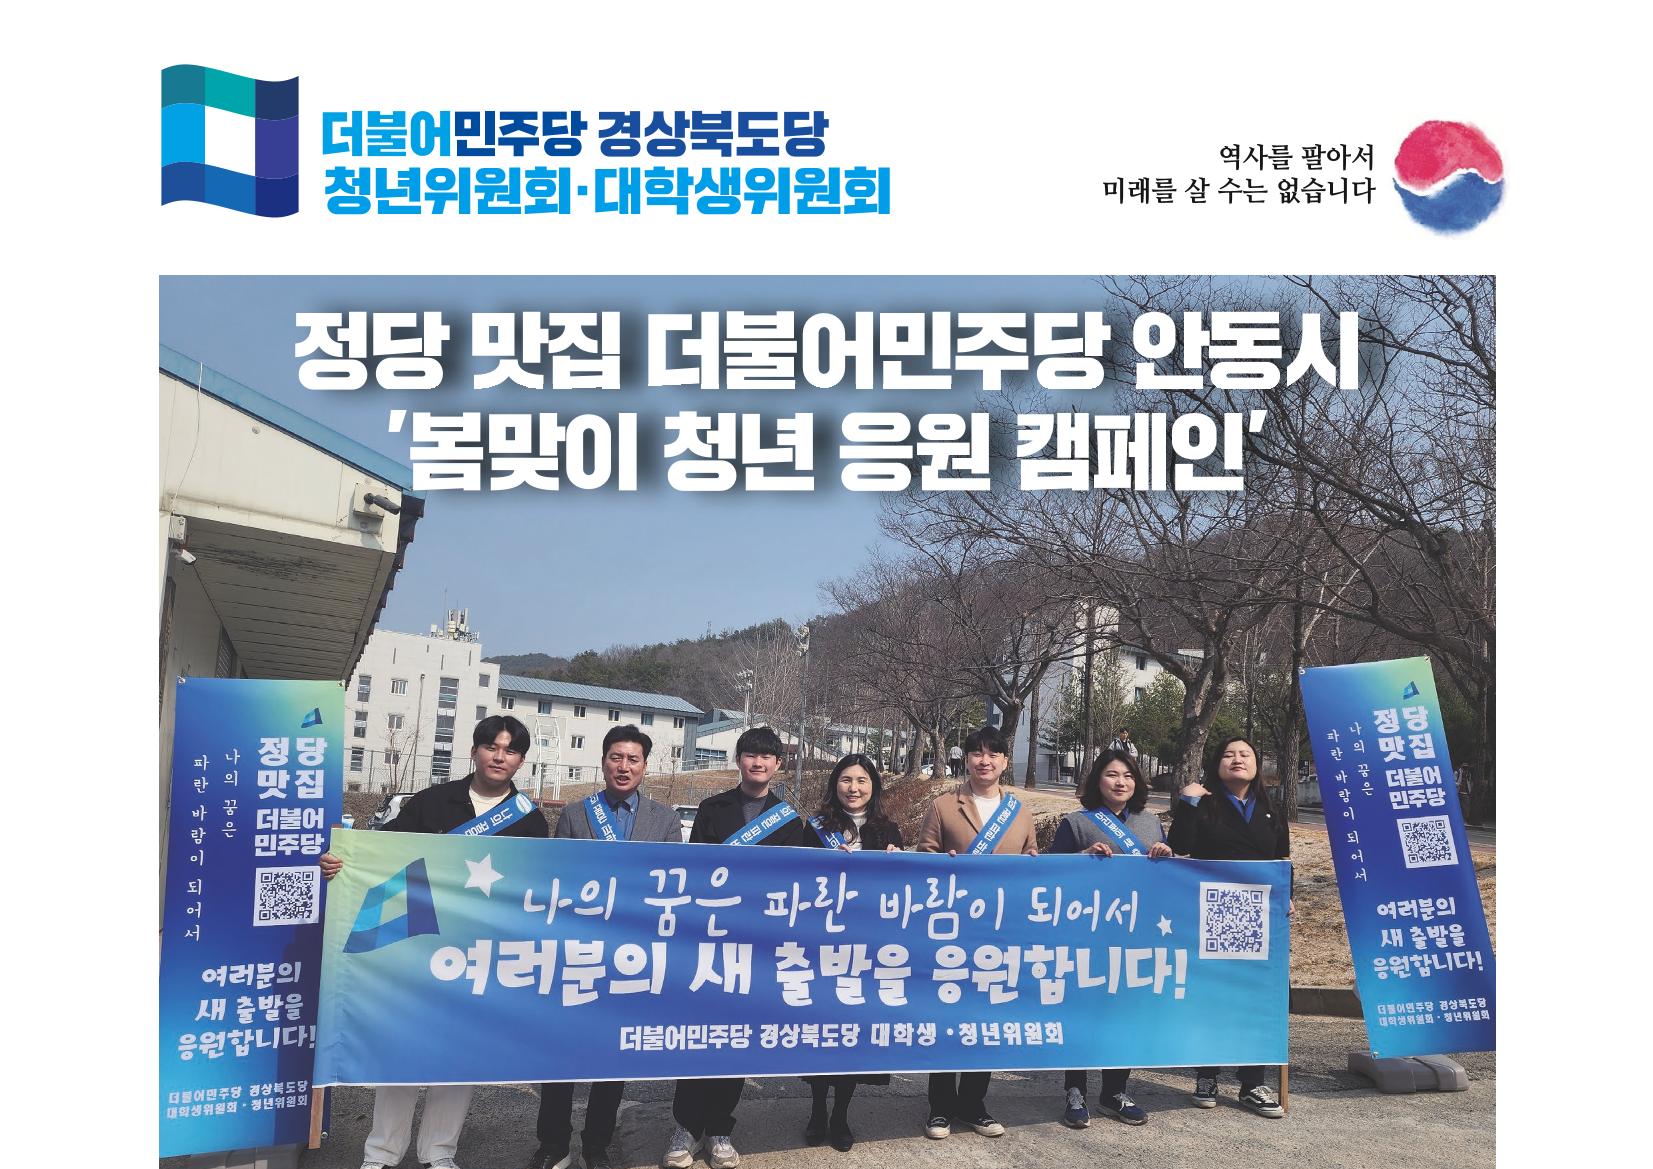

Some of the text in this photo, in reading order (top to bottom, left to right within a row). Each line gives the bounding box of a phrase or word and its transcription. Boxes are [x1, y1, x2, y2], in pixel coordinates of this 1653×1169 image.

[1373, 706, 1429, 734] 정당
[258, 737, 328, 766] 정당
[1350, 722, 1374, 796] 나의 꿈은
[1378, 733, 1436, 763] 맛집
[257, 770, 325, 799] 맛집
[1385, 766, 1442, 788] 더불어
[222, 748, 240, 838] 나의 꿈은
[1328, 729, 1343, 761] 파란
[1347, 831, 1367, 882] 되어서
[1389, 788, 1446, 810] 민주당
[256, 808, 324, 830] 더불어
[184, 754, 210, 941] 파란 바람이 되어서
[255, 833, 324, 856] 민주당
[523, 866, 1138, 940] 나의 꿈은 파란 바람이 되어서
[1377, 897, 1456, 921] 여러분의
[1381, 924, 1466, 950] 새 출발을
[202, 961, 302, 990] 여러분의
[430, 939, 1188, 1007] 여러분의 새 출발을 응원합니다!
[1373, 951, 1484, 979] 응원합니다!
[195, 993, 304, 1024] 새 출발을
[178, 1025, 317, 1061] 응원합니다!
[619, 1024, 753, 1051] 더불어민주당
[760, 1023, 861, 1049] 경상북도당
[870, 1022, 937, 1047] 대학생
[168, 1080, 308, 1104] 더불어민주당 경상북도당
